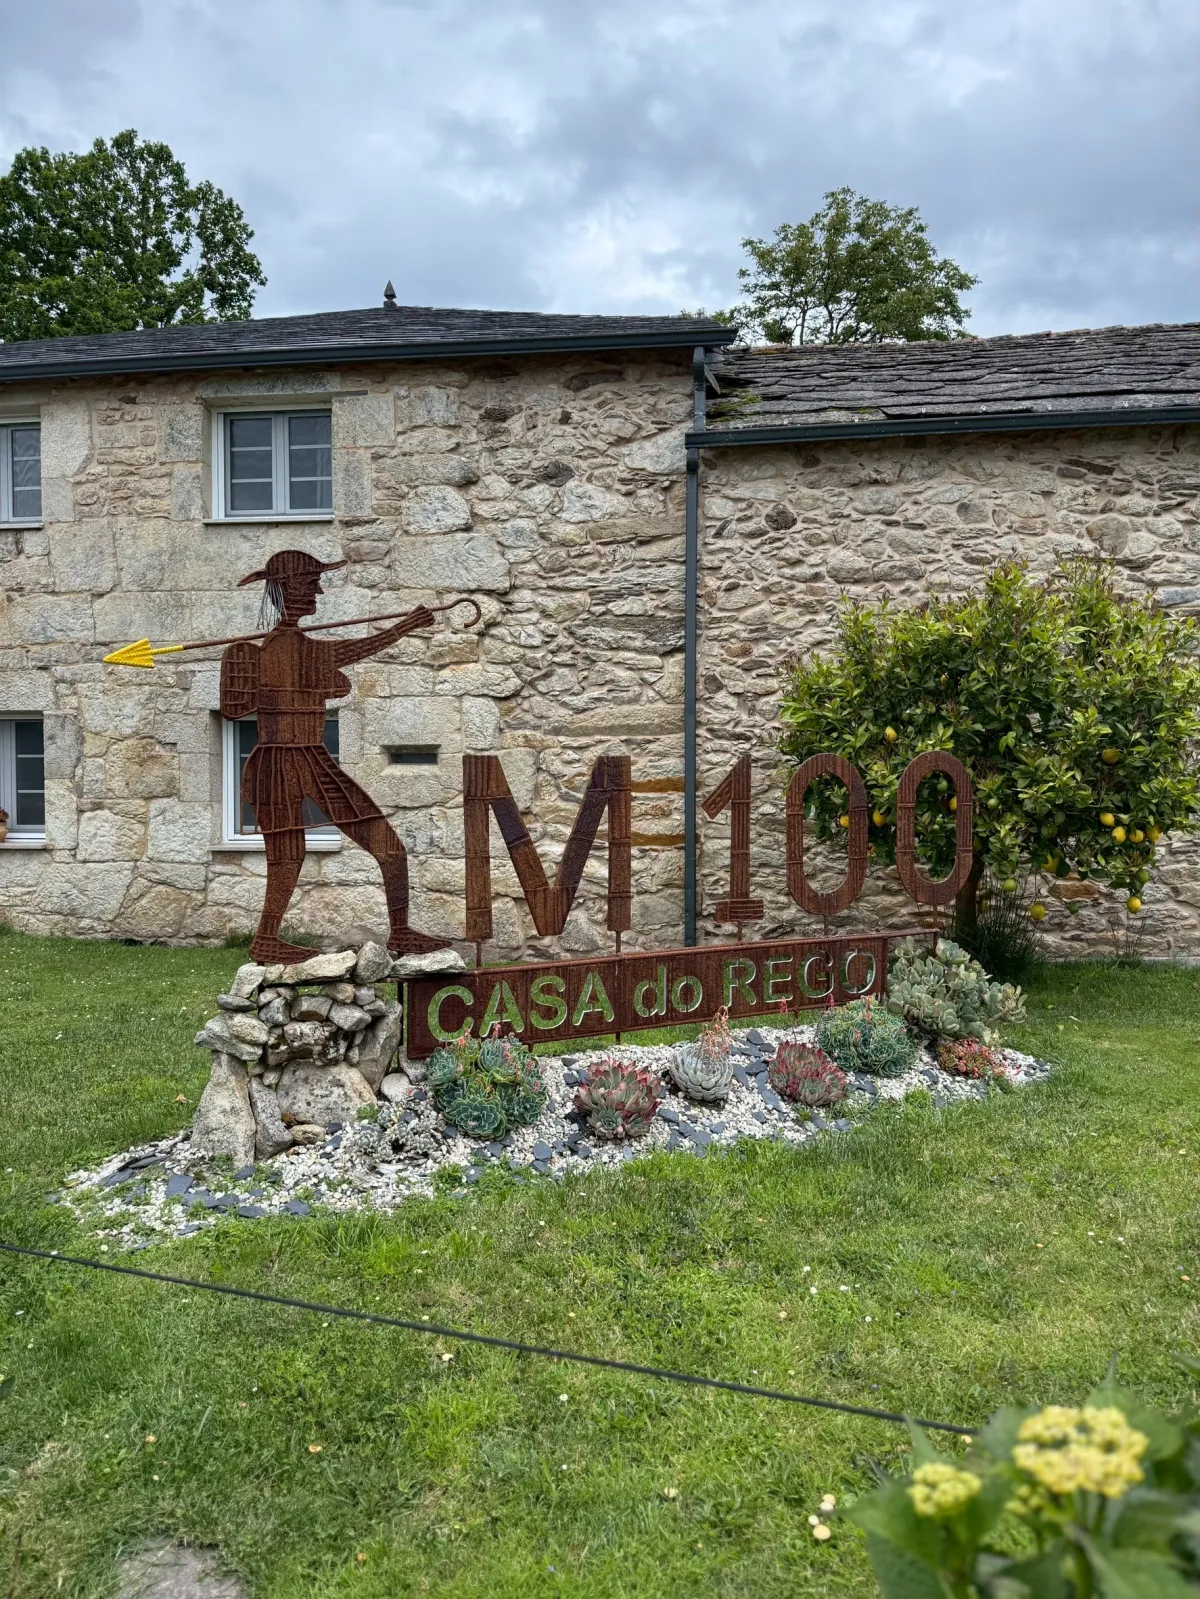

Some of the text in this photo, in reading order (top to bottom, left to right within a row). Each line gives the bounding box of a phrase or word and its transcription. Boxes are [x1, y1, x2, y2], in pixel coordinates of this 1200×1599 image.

[462, 750, 973, 941] M 100
[427, 948, 877, 1042] CASA do REGO
